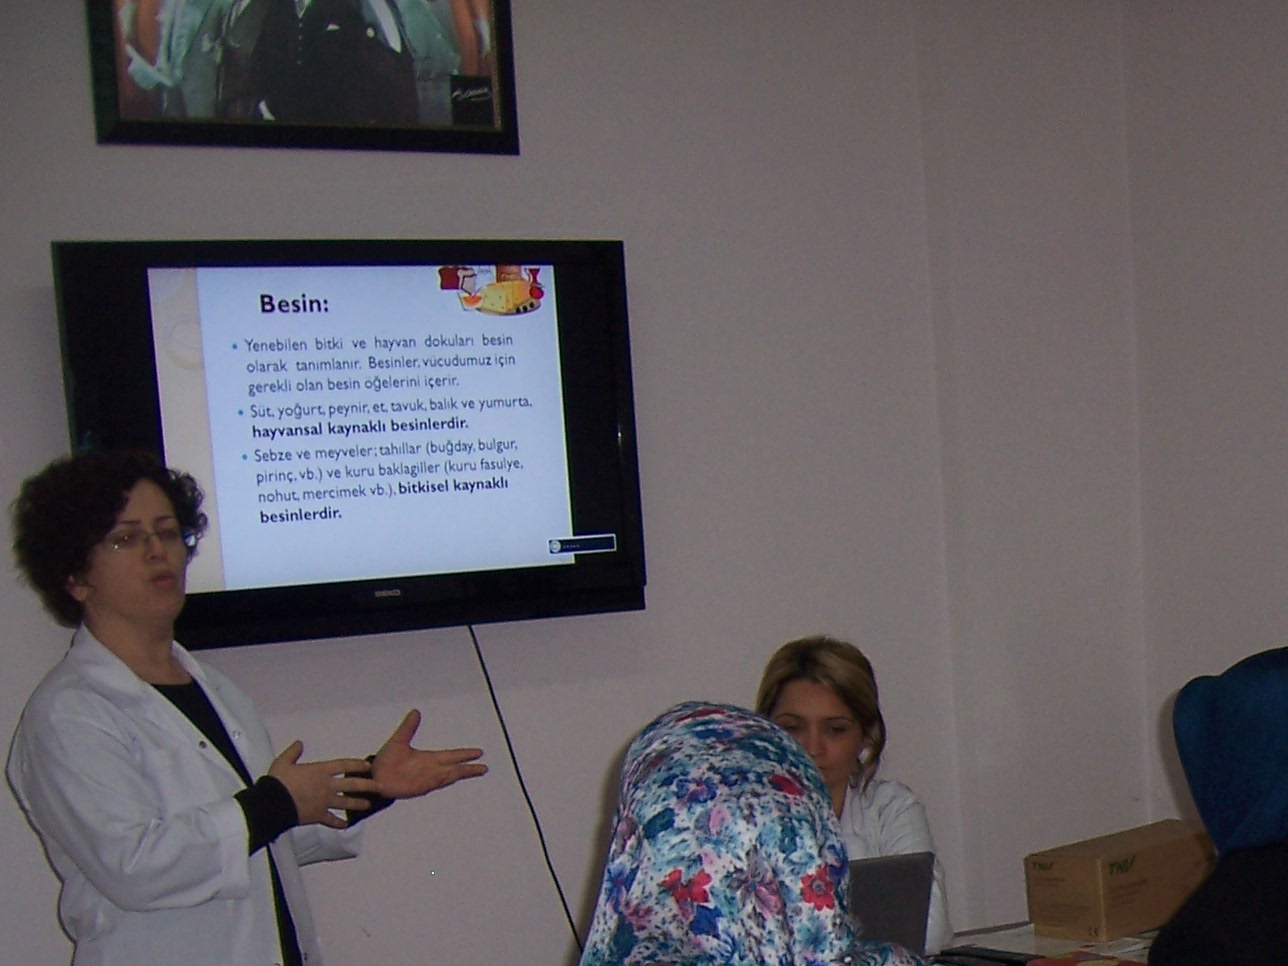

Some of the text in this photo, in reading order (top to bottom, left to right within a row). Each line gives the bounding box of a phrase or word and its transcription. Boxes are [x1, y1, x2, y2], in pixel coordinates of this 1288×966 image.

[260, 293, 329, 314] Besin:
[244, 333, 513, 352] Yenebilen bitki ve hayvan dokuları besin
[246, 359, 288, 373] olarak
[495, 353, 516, 367] için
[248, 378, 292, 397] gerekli
[296, 378, 323, 392] olan
[327, 377, 360, 391] besin
[425, 375, 459, 390] içerir.
[328, 401, 370, 418] peynir,
[391, 398, 428, 412] tavuk,
[461, 400, 475, 410] ve
[479, 397, 533, 412] yumurta,
[252, 416, 469, 441] hayvansal kaynaklı besinlerdir.
[254, 449, 292, 462] Sebze
[296, 450, 311, 460] ve
[478, 438, 518, 454] bulgur,
[300, 467, 323, 483] vb.)
[326, 468, 341, 479] ve
[345, 465, 375, 478] kuru
[378, 461, 440, 478] baklagiller
[444, 459, 477, 475] (kuru
[480, 457, 524, 473] fasulye,
[258, 489, 300, 503] nohut,
[303, 484, 367, 500] mercimek
[398, 479, 449, 495] bitkisel
[453, 476, 509, 493] kaynaklı
[260, 506, 342, 524] besinlerdir.
